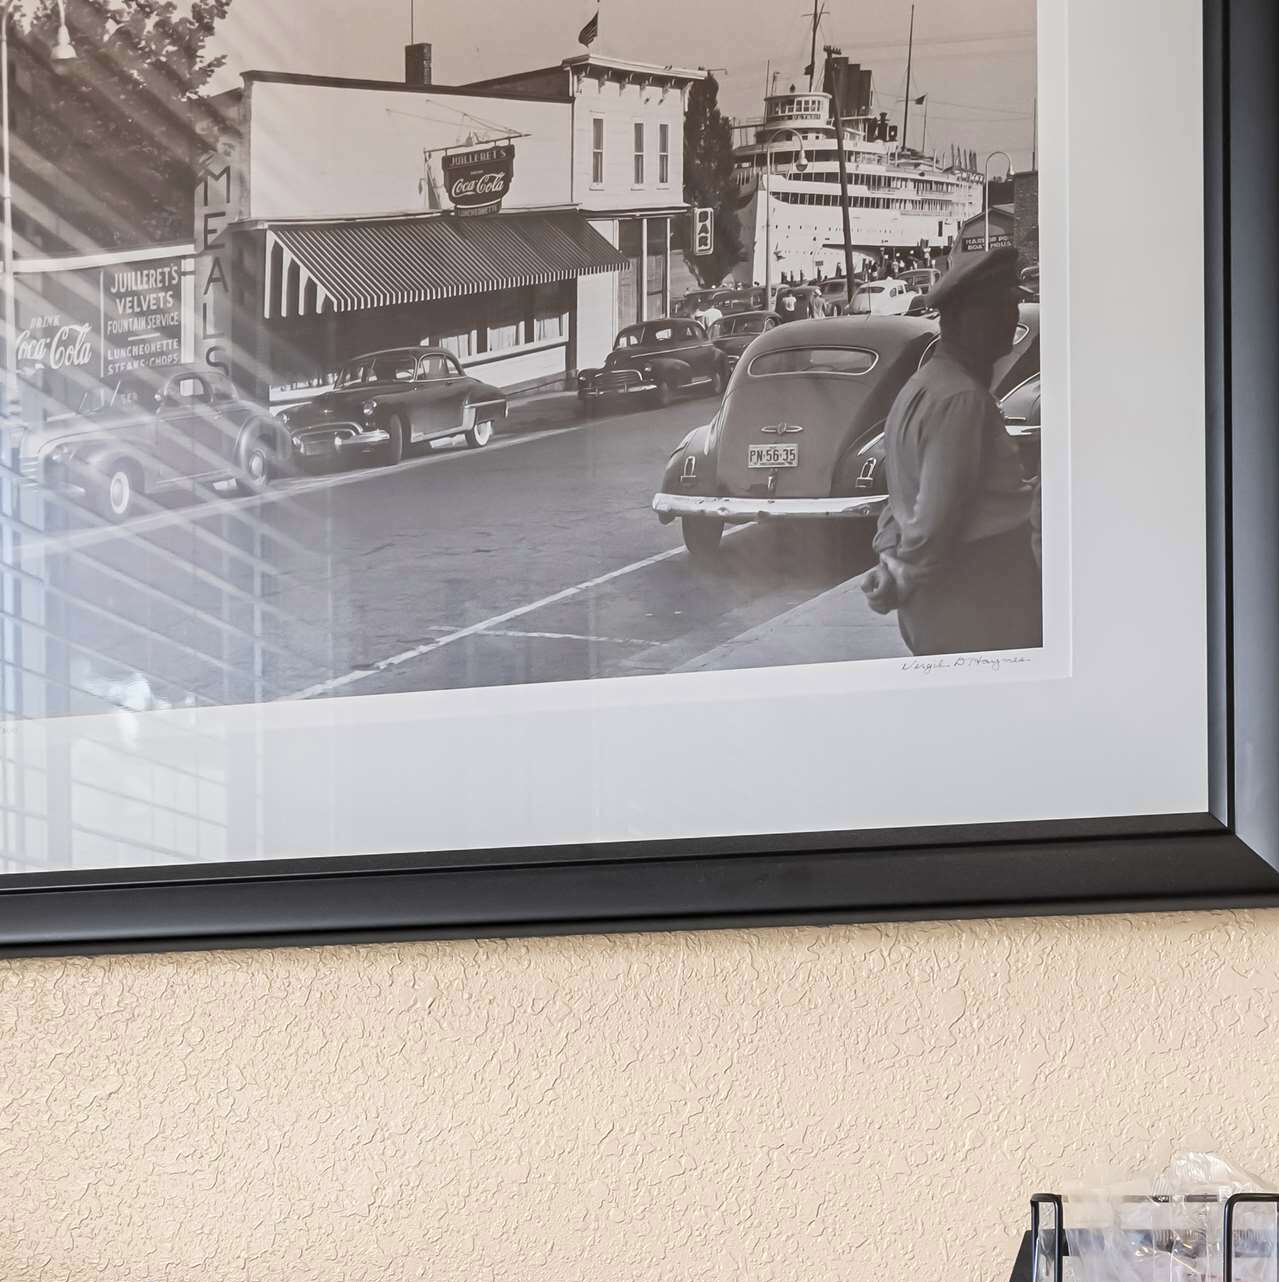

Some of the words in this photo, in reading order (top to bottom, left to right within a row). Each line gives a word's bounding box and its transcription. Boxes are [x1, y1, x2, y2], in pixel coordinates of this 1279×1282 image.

[111, 264, 178, 293] JUILLERET'S
[203, 165, 230, 377] MEALS
[116, 291, 173, 314] VELVETS
[29, 315, 60, 329] DRINK
[107, 316, 146, 335] FOUNTAIN
[147, 312, 179, 328] SERVICE
[108, 338, 179, 360] LUNCHEONETTE
